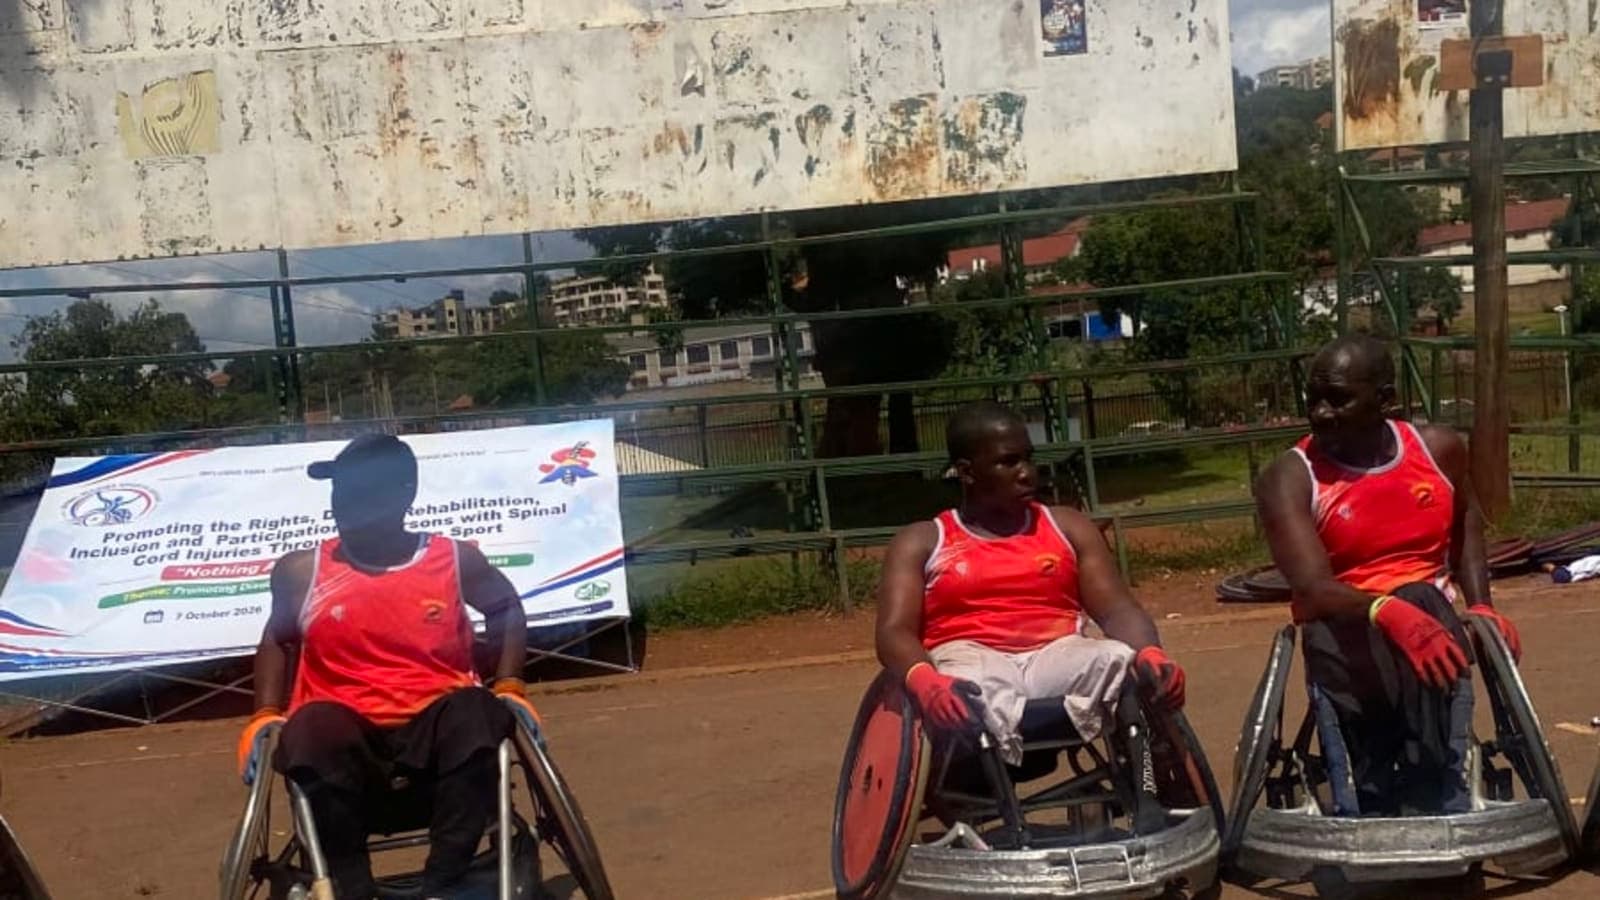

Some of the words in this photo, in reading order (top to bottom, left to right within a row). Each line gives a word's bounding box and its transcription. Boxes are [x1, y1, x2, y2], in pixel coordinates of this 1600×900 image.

[70, 539, 160, 559] Inclusion
[166, 535, 203, 548] and
[460, 508, 502, 524] with
[508, 503, 567, 521] Spinal
[102, 522, 203, 544] Promoting
[210, 520, 242, 533] the
[248, 515, 315, 532] Rights,
[133, 549, 181, 567] Cord
[186, 546, 261, 563] Injuries
[450, 523, 503, 539] Sport
[185, 610, 230, 620] October
